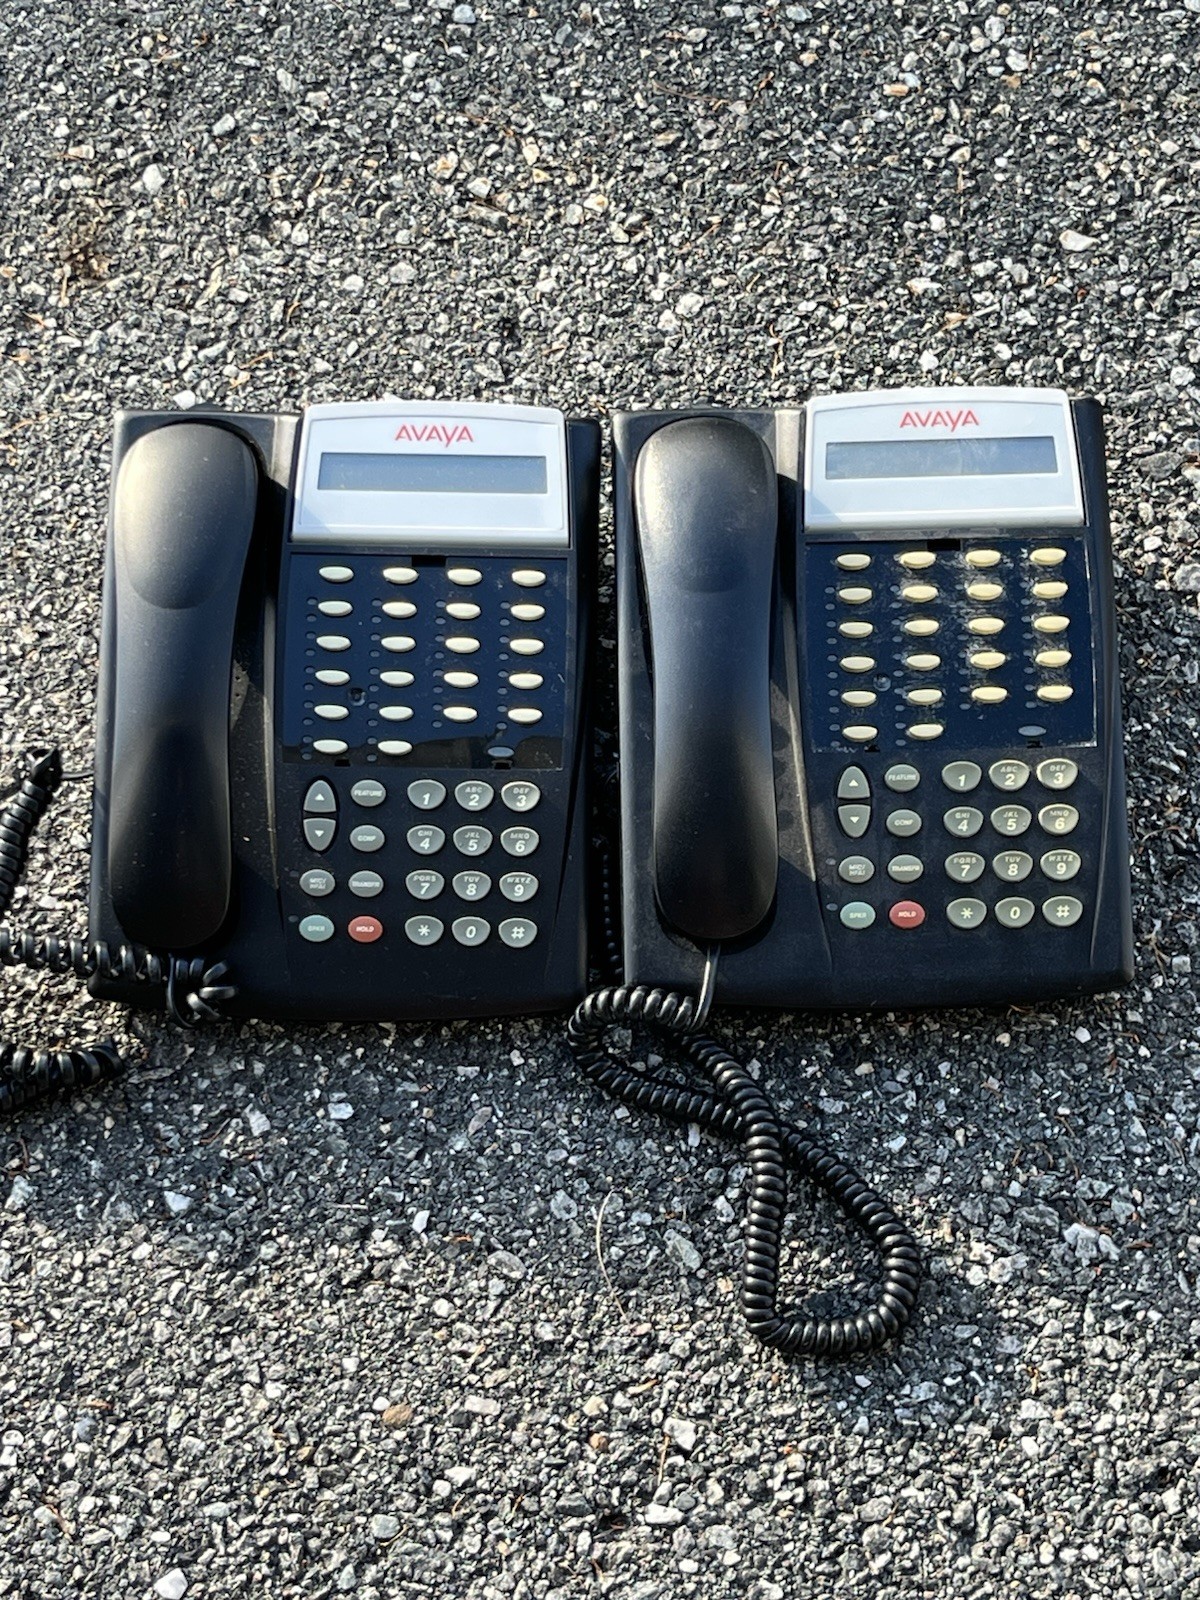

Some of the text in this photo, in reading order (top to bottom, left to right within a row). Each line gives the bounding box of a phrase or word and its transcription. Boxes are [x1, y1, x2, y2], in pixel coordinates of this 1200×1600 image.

[899, 409, 980, 432] AVAYA
[395, 424, 474, 447] AVAYA
[958, 774, 966, 787] 1
[1004, 774, 1016, 785] 2
[1053, 772, 1064, 784] 3
[422, 793, 431, 805] 1
[468, 794, 480, 806] 2
[516, 795, 527, 807] 3
[958, 820, 968, 831] 4
[1006, 819, 1017, 830] 5
[1054, 818, 1065, 829] 6
[420, 838, 430, 849] 4
[468, 839, 478, 851] 5
[515, 841, 526, 852] 6
[961, 865, 971, 877] 7
[1008, 864, 1018, 875] 8
[1056, 862, 1067, 874] 9
[420, 883, 431, 894] 7
[466, 884, 477, 895] 8
[514, 884, 524, 896] 9
[1009, 907, 1021, 919] 0
[465, 926, 477, 938] 0
